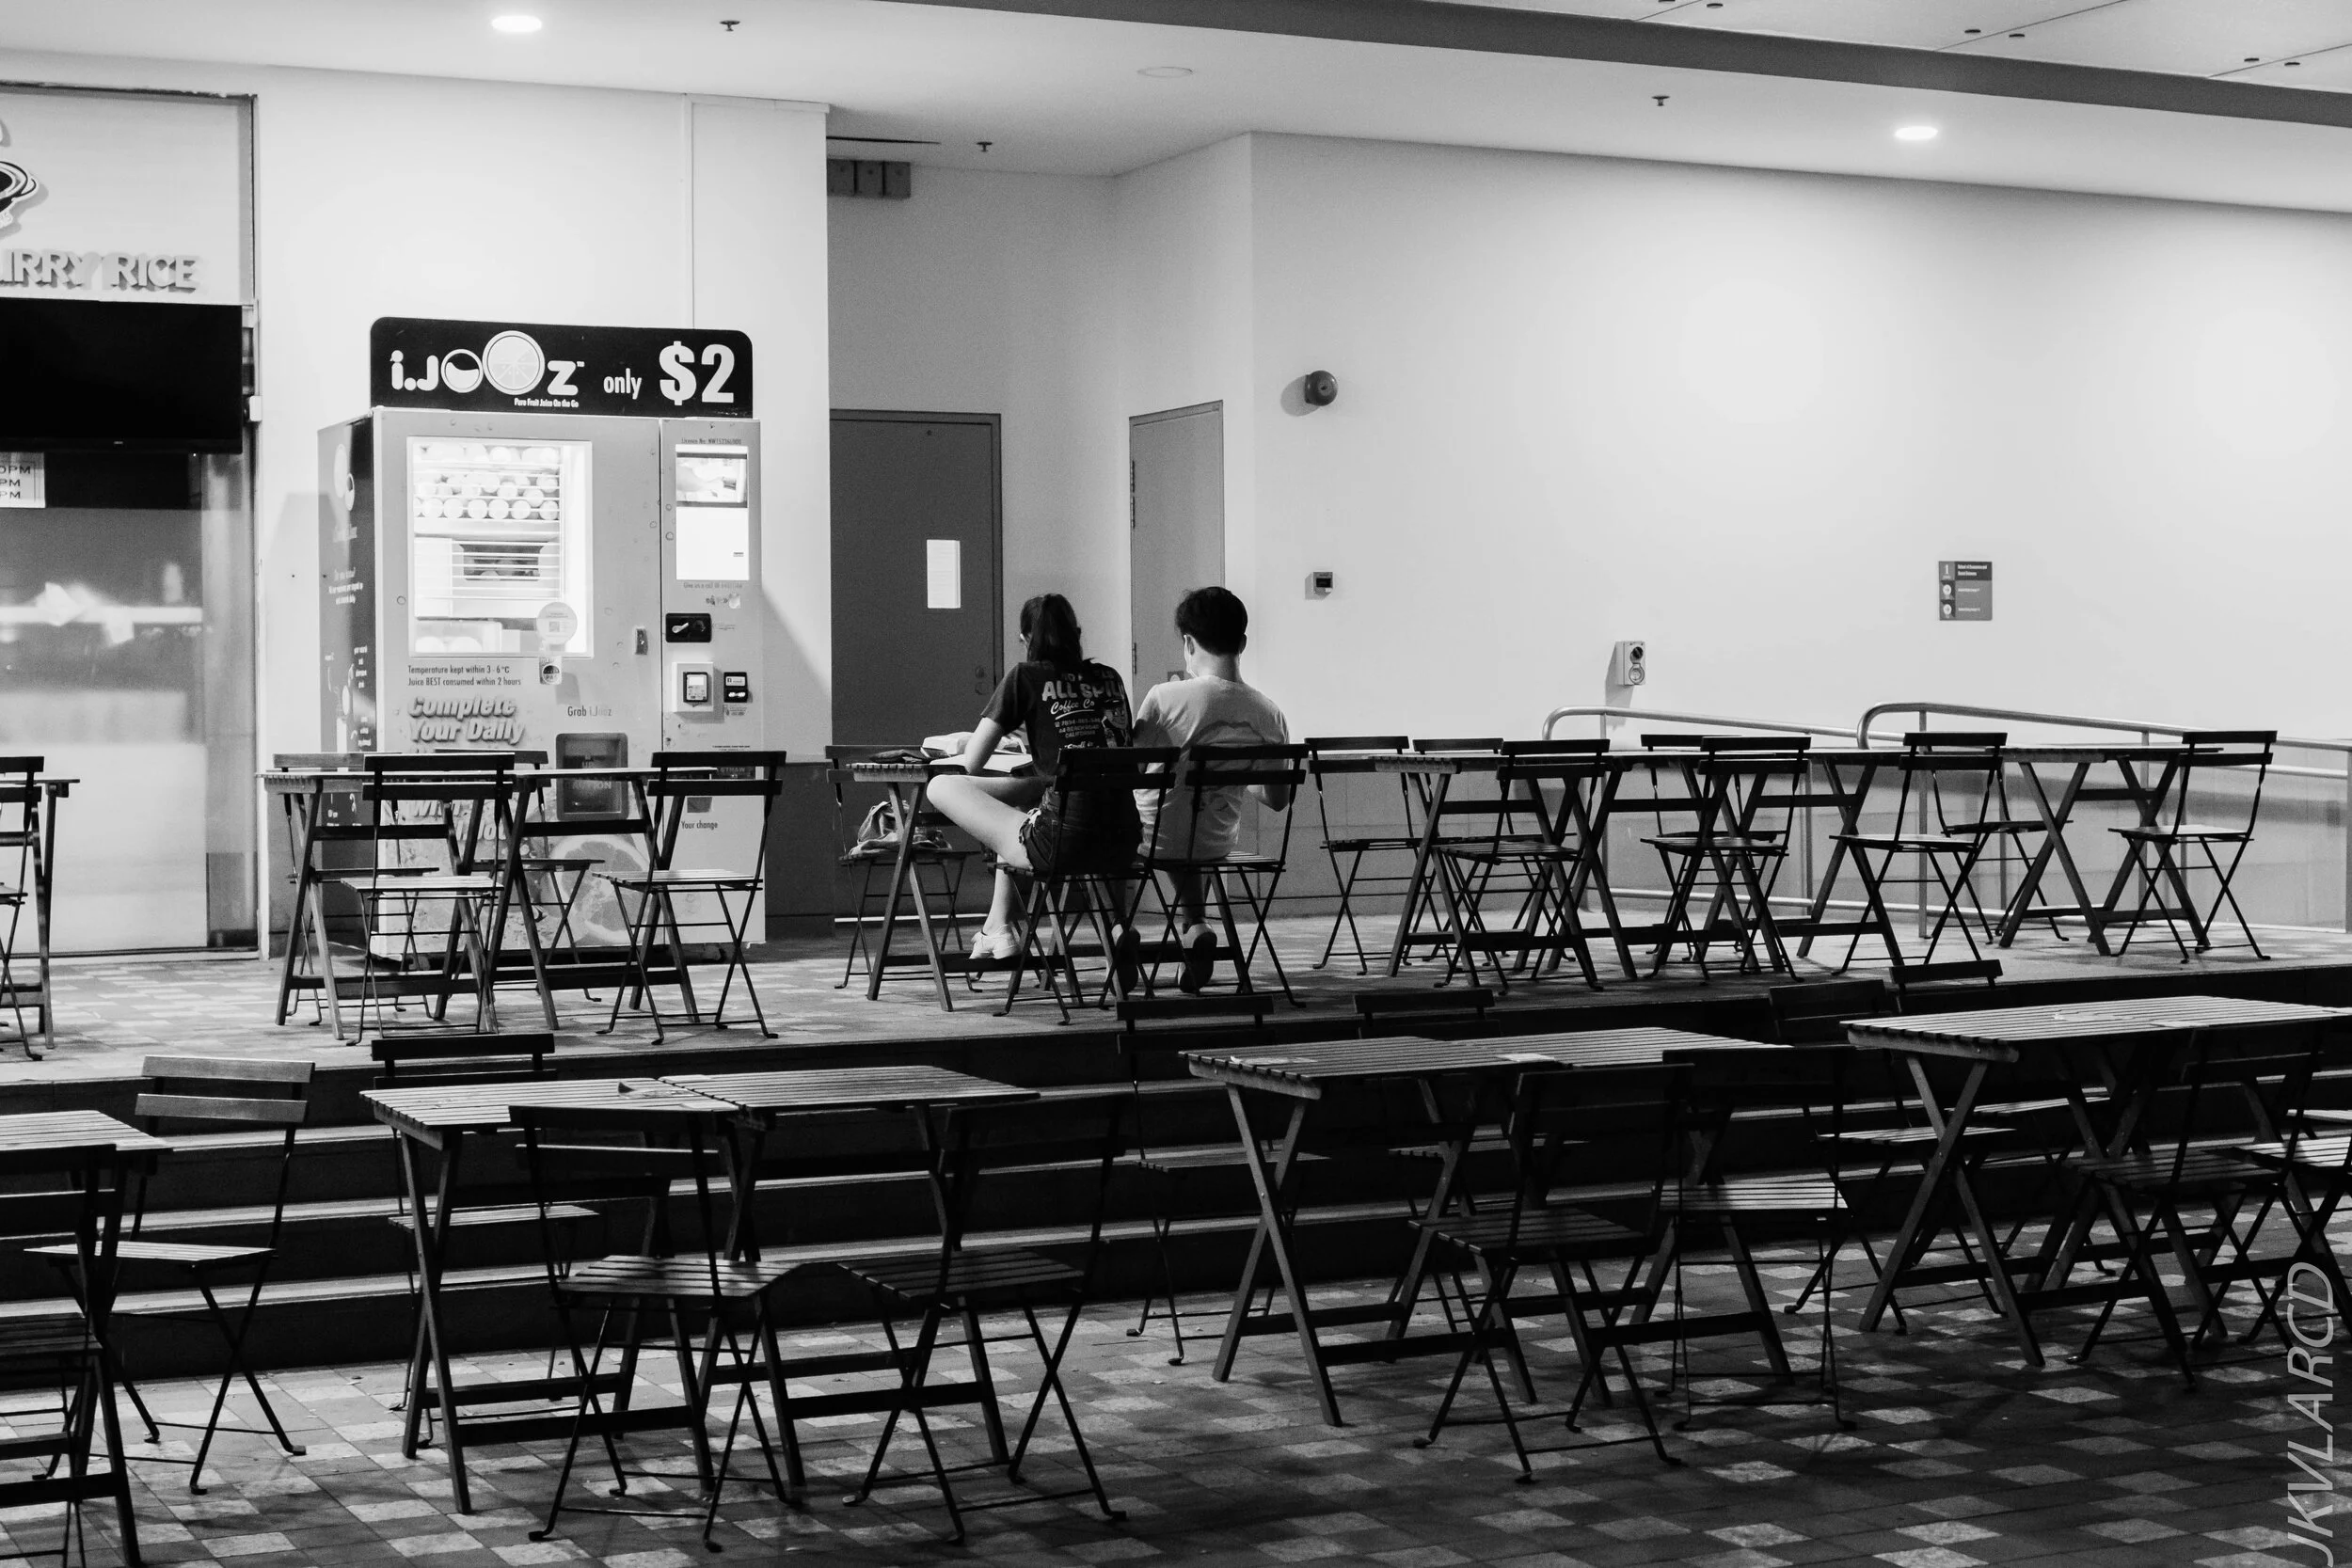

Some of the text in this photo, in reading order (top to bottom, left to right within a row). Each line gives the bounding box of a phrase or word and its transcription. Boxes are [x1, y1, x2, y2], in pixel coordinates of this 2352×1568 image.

[106, 253, 199, 291] RICE
[603, 368, 643, 399] only
[658, 341, 736, 405] $2
[407, 664, 449, 675] Temperature
[450, 664, 464, 675] kept
[465, 664, 485, 674] within
[486, 665, 491, 674] 3
[496, 665, 501, 674] 6
[407, 677, 521, 687] Juice BEST consumed within 2 hours
[1041, 680, 1078, 702] ALL
[408, 695, 517, 722] Complete
[567, 705, 587, 717] Grab
[1050, 700, 1080, 715] Coffee
[410, 718, 526, 746] Your Daily
[681, 819, 718, 831] Your change
